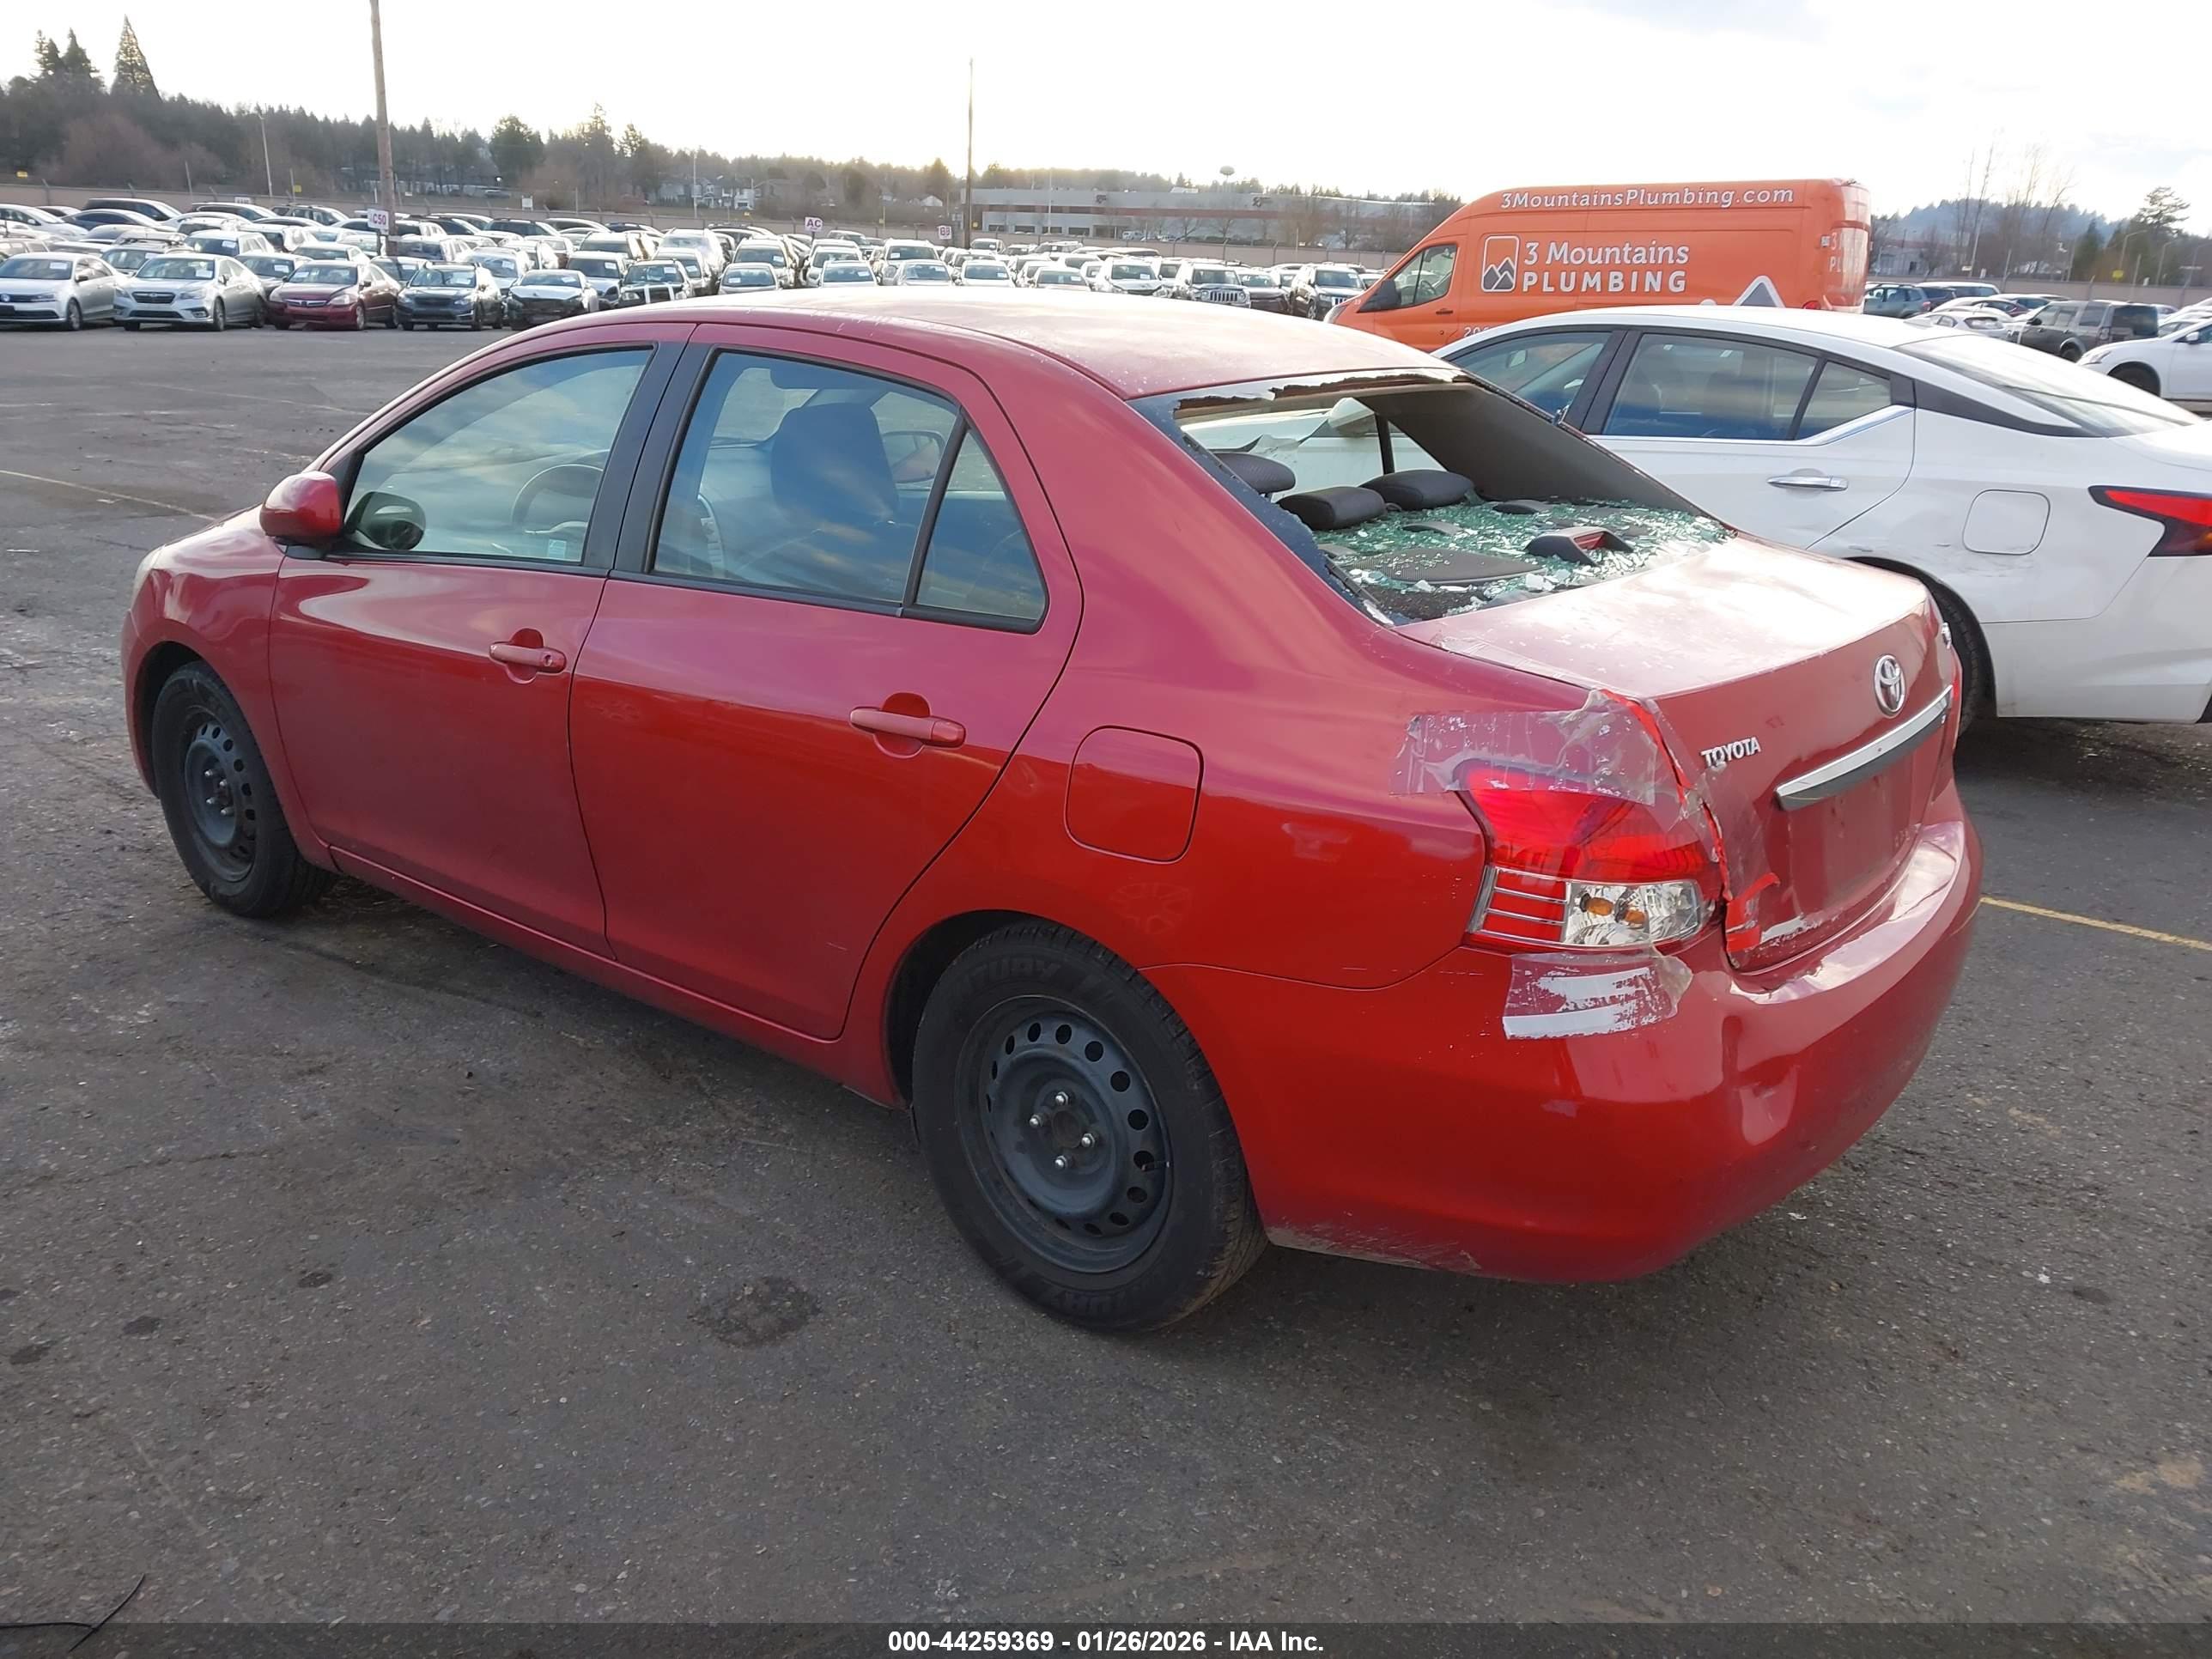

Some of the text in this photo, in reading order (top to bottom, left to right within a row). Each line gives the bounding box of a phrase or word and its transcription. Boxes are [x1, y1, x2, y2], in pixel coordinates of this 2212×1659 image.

[1501, 187, 1795, 209] 3MountainsPlumbing.com
[806, 218, 822, 228] AC
[1524, 240, 1690, 265] 3 Mountains
[1522, 270, 1687, 293] PLUMBING
[1700, 736, 1762, 768] TOYOTA
